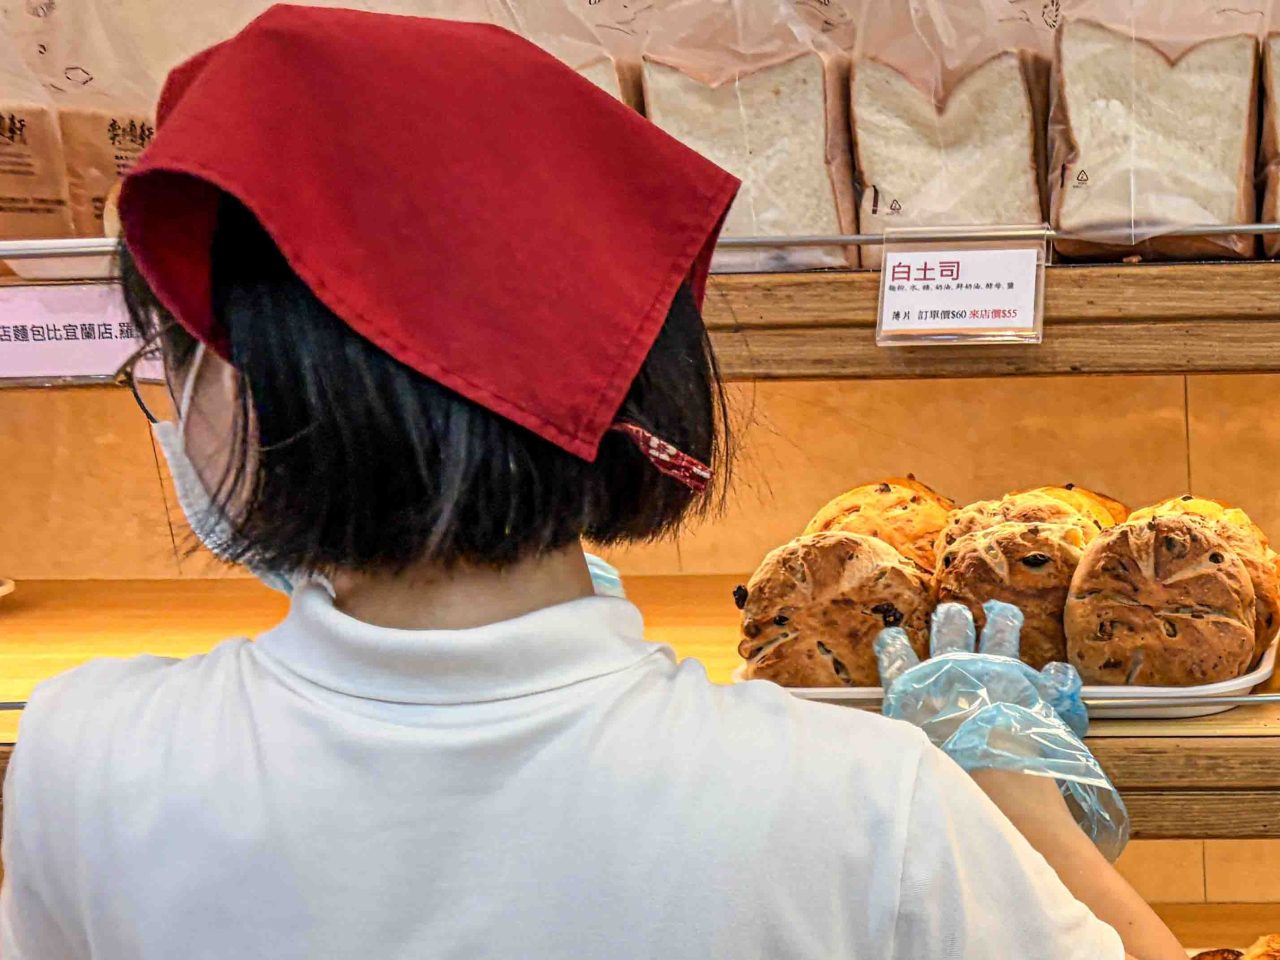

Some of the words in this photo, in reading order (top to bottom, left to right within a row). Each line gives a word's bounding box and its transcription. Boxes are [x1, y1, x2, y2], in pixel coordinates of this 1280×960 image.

[891, 261, 960, 282] 白土司
[917, 309, 967, 320] 訂單價$60
[969, 309, 1018, 320] 來店價$55
